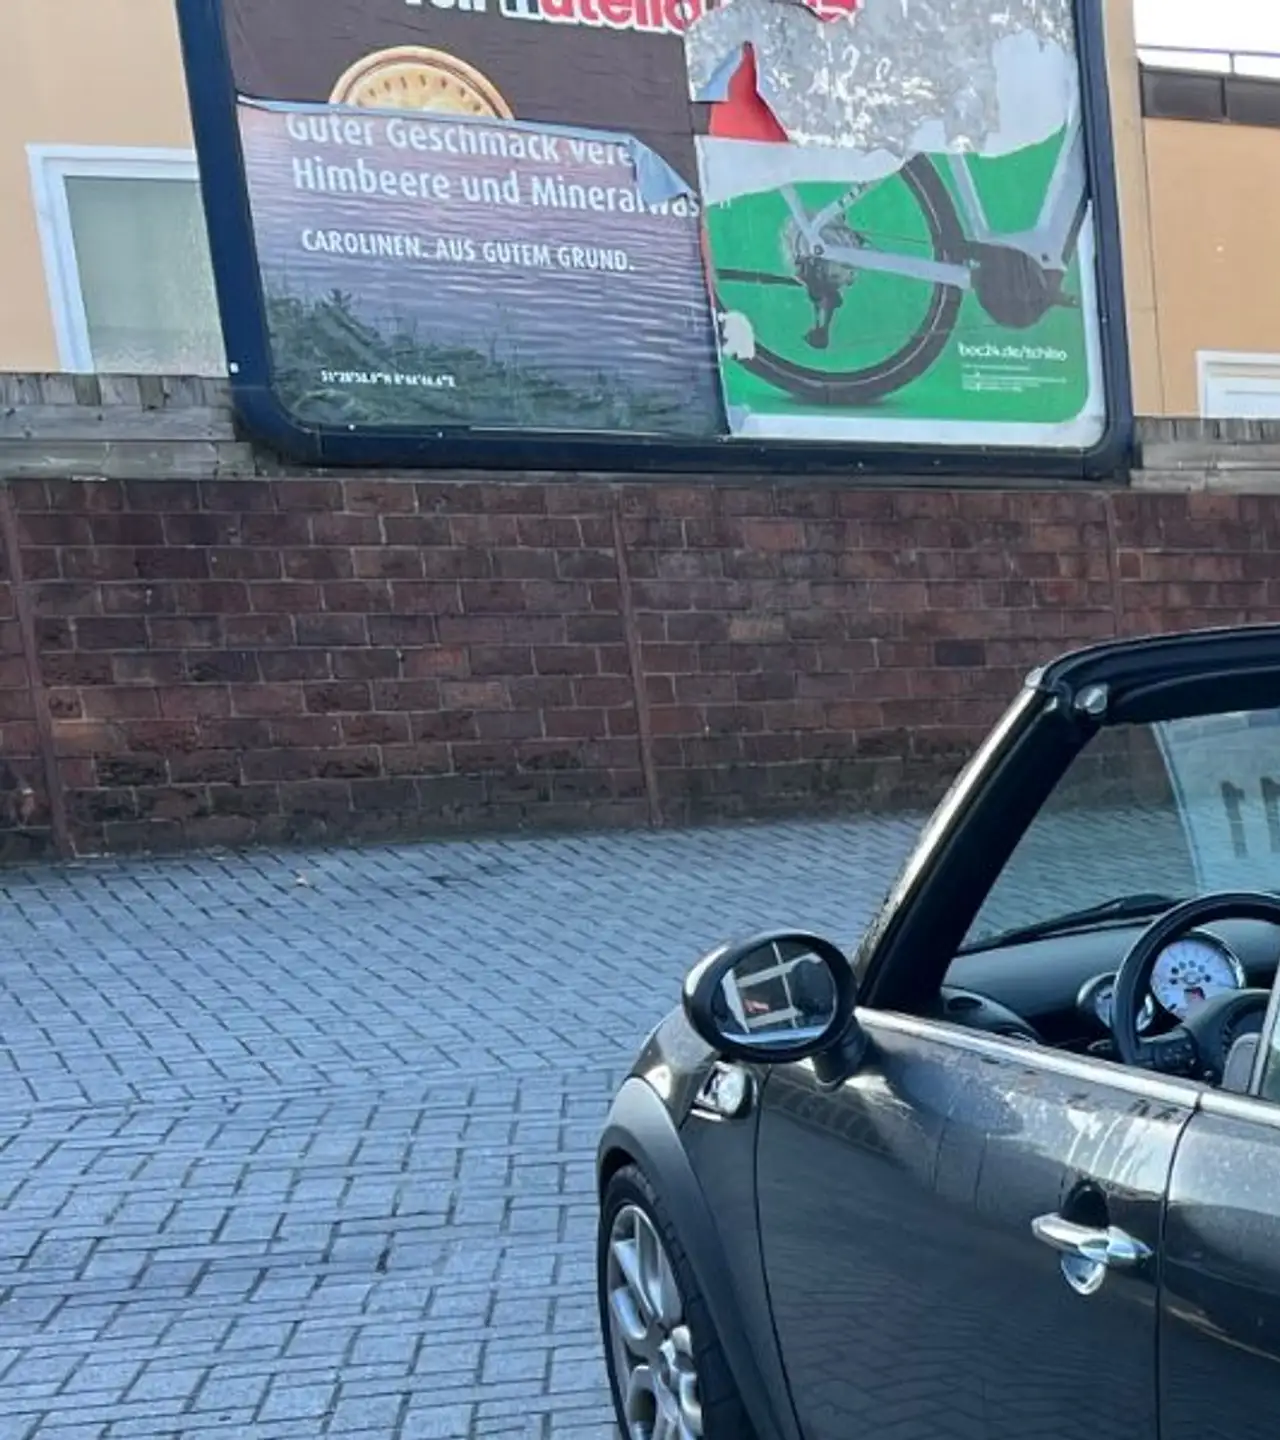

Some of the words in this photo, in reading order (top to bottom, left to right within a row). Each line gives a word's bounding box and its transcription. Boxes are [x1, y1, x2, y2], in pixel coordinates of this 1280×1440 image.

[285, 113, 374, 147] Guter
[386, 117, 560, 163] Geschmack
[292, 156, 450, 199] Himbeere
[460, 170, 520, 203] und
[302, 229, 430, 258] CAROLINEN.
[436, 238, 476, 262] AUS
[483, 239, 551, 267] GUTEM
[557, 248, 636, 272] GRUND.
